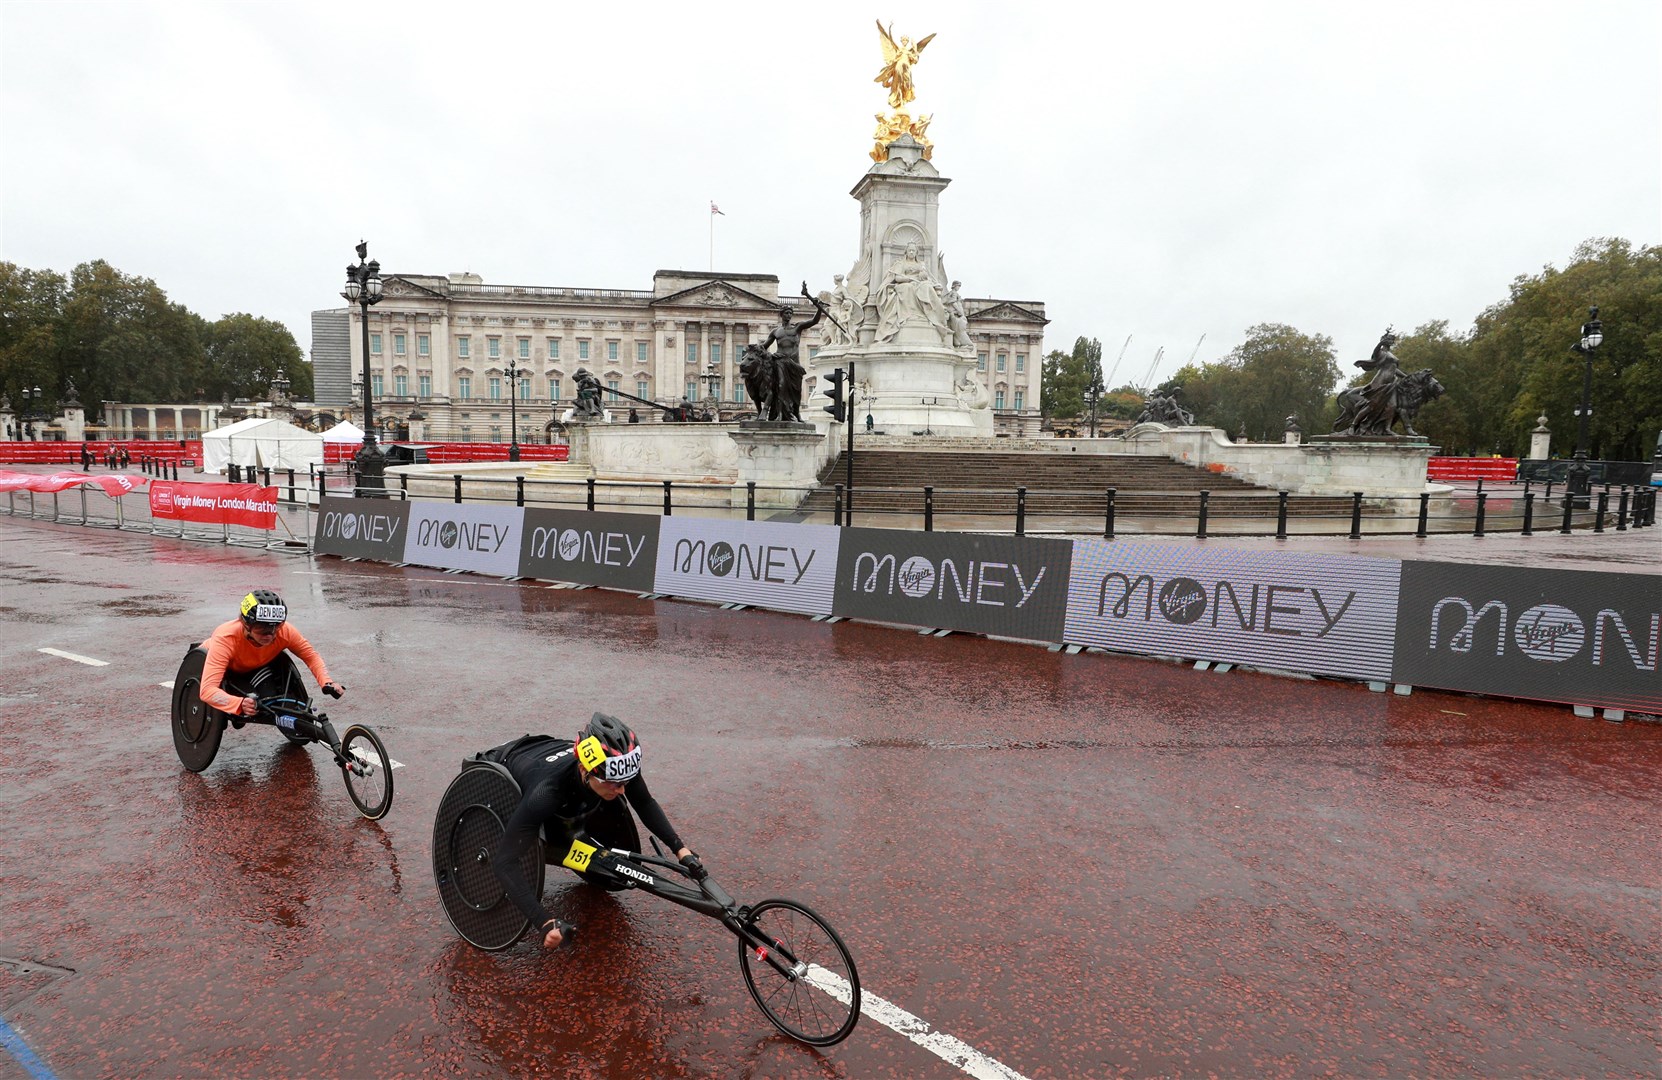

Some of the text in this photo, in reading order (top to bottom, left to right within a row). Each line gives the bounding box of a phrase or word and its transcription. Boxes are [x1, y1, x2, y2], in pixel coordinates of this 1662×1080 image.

[173, 495, 192, 509] Virgin
[192, 495, 217, 511] Money
[217, 496, 245, 510] London
[322, 511, 400, 543] MONEY
[417, 518, 509, 553] MONEY
[531, 526, 646, 567] MONEY
[673, 538, 816, 585] MONEY
[709, 545, 733, 572] Virgin
[852, 552, 1046, 608] MONEY
[901, 561, 932, 592] Virgin
[258, 606, 271, 618] DEN
[1097, 572, 1356, 638] MONEY
[1162, 583, 1203, 618] Virgin
[1521, 611, 1578, 654] Virgin
[582, 741, 598, 767] 151
[570, 848, 589, 865] 151
[614, 863, 655, 885] HONDA
